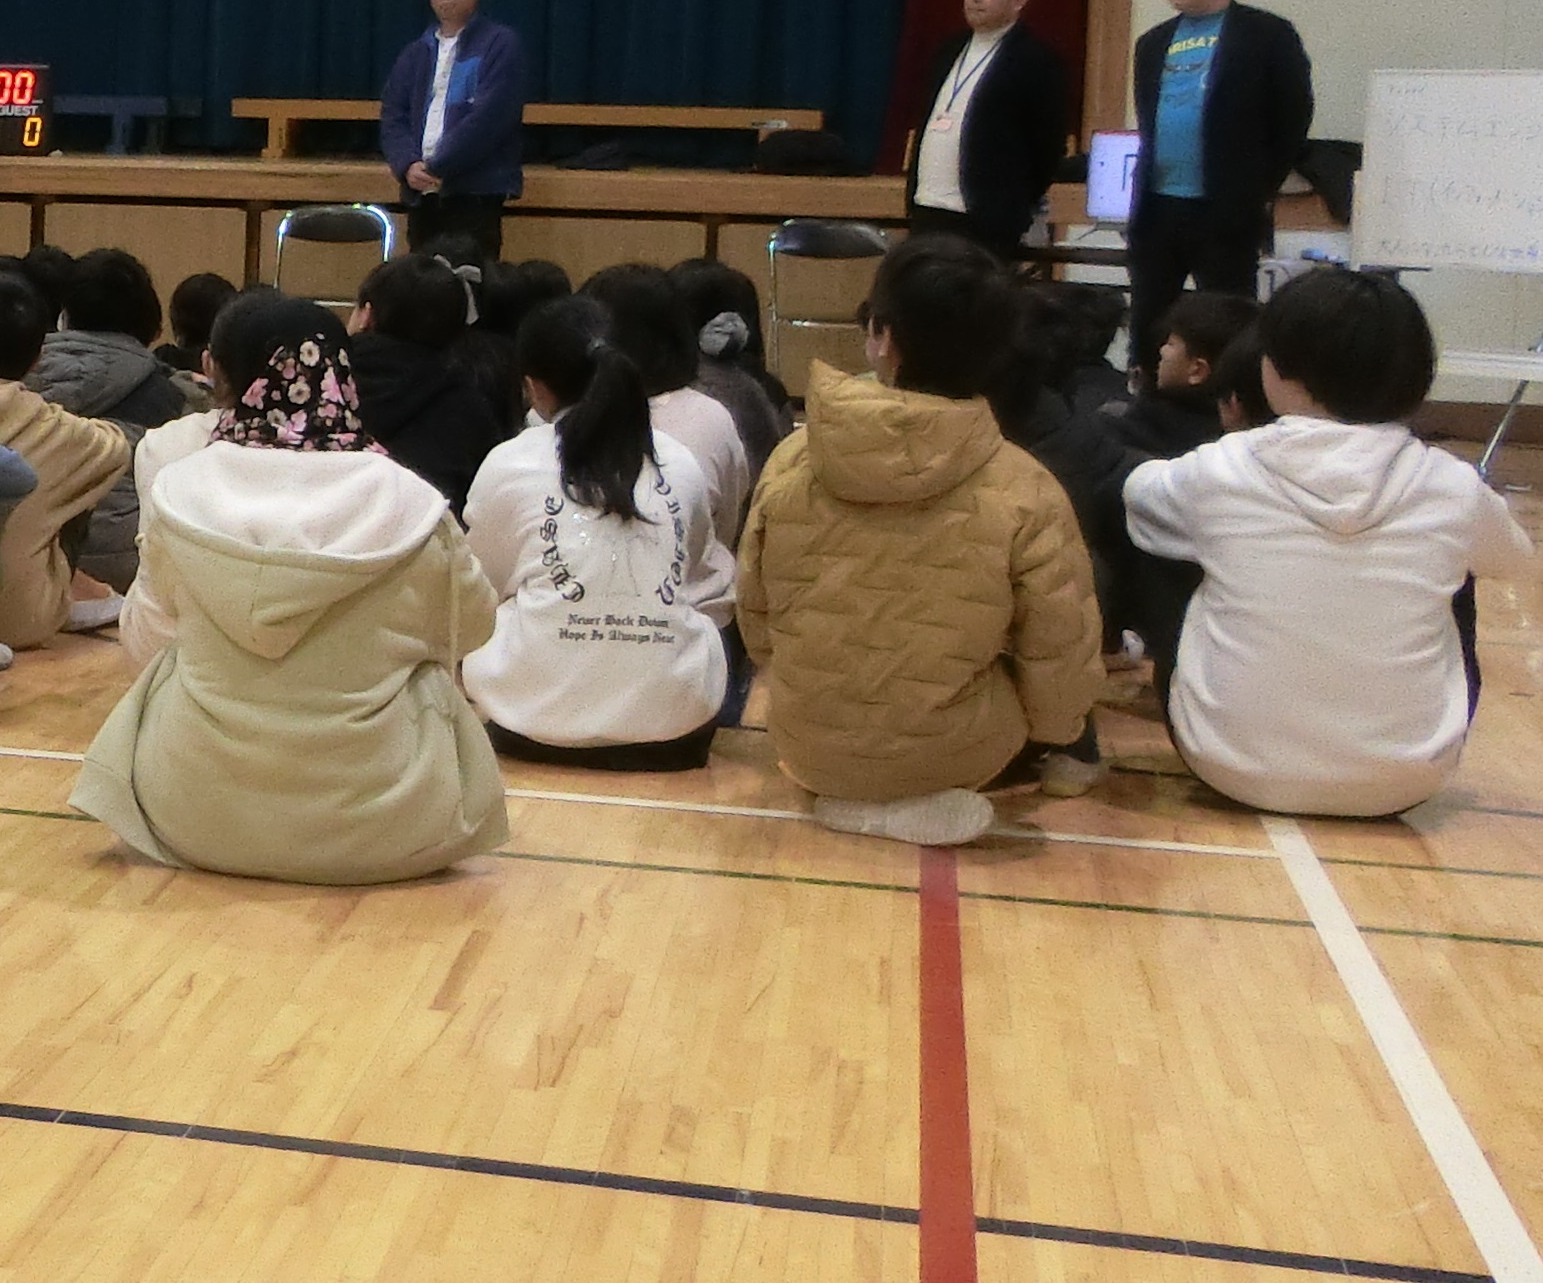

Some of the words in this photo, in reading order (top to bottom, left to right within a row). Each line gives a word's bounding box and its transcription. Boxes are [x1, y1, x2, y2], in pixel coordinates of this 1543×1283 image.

[22, 116, 42, 147] 0
[567, 614, 601, 627] Never
[605, 614, 634, 626] Back
[638, 615, 669, 628] Down
[559, 627, 586, 641] Hope
[590, 629, 604, 641] Is
[609, 630, 650, 644] Always
